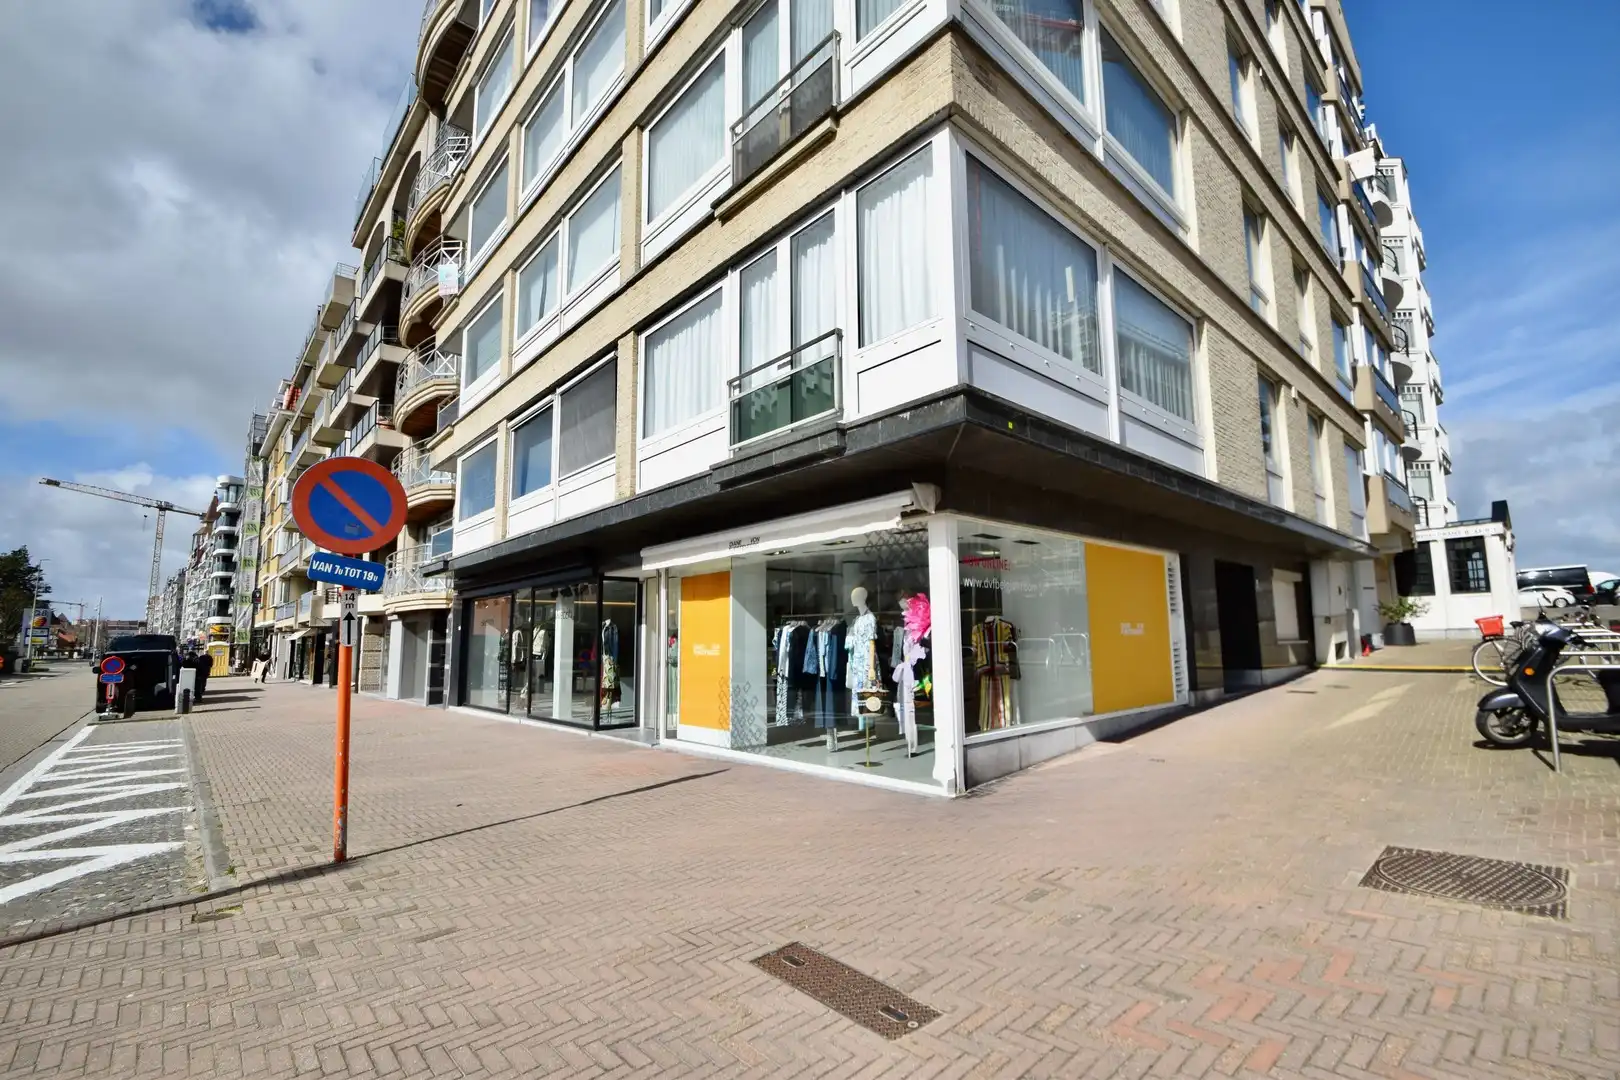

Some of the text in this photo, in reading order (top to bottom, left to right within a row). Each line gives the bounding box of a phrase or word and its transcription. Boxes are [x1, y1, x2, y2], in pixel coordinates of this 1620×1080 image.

[312, 560, 332, 574] VAN
[344, 566, 362, 579] TOT
[345, 592, 356, 602] 14
